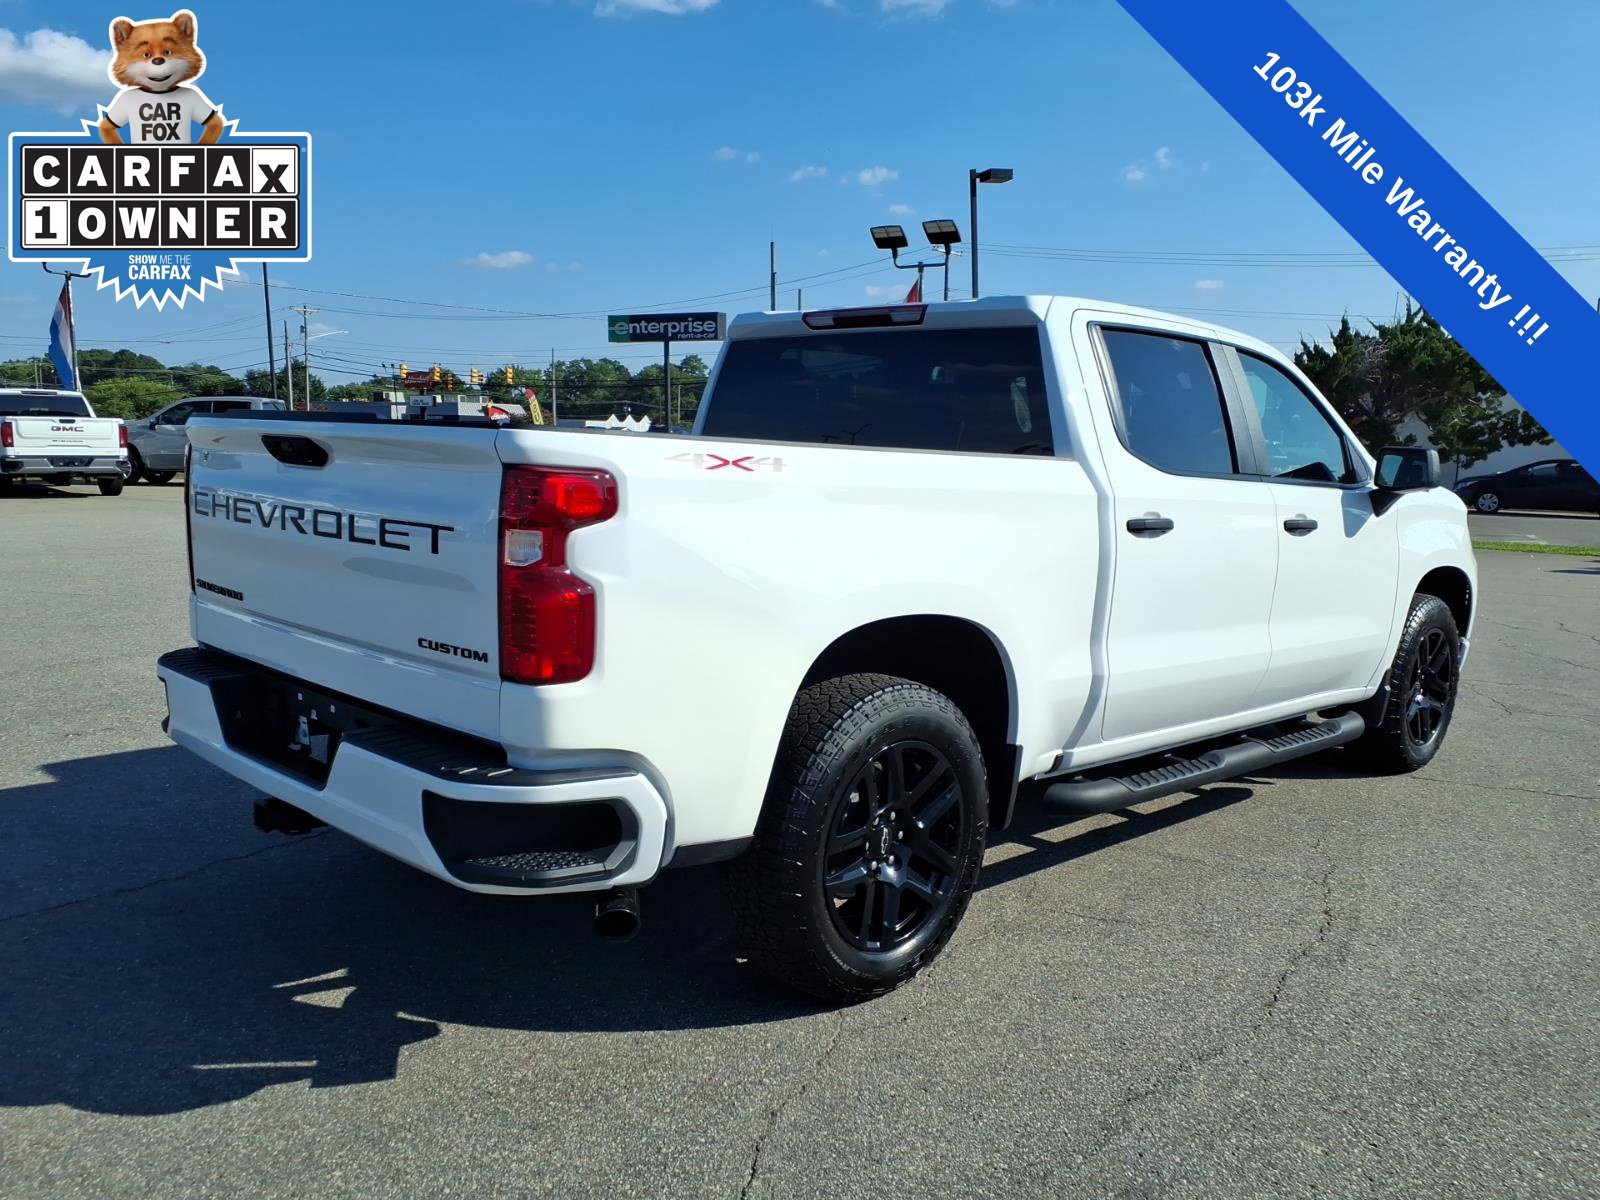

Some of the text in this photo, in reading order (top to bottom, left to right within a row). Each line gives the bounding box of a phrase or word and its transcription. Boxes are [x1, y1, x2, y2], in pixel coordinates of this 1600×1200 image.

[608, 317, 717, 337] enterprise
[677, 332, 717, 340] rent-a-car
[194, 490, 455, 555] CHEVROLET
[417, 637, 488, 664] CUSTOM
